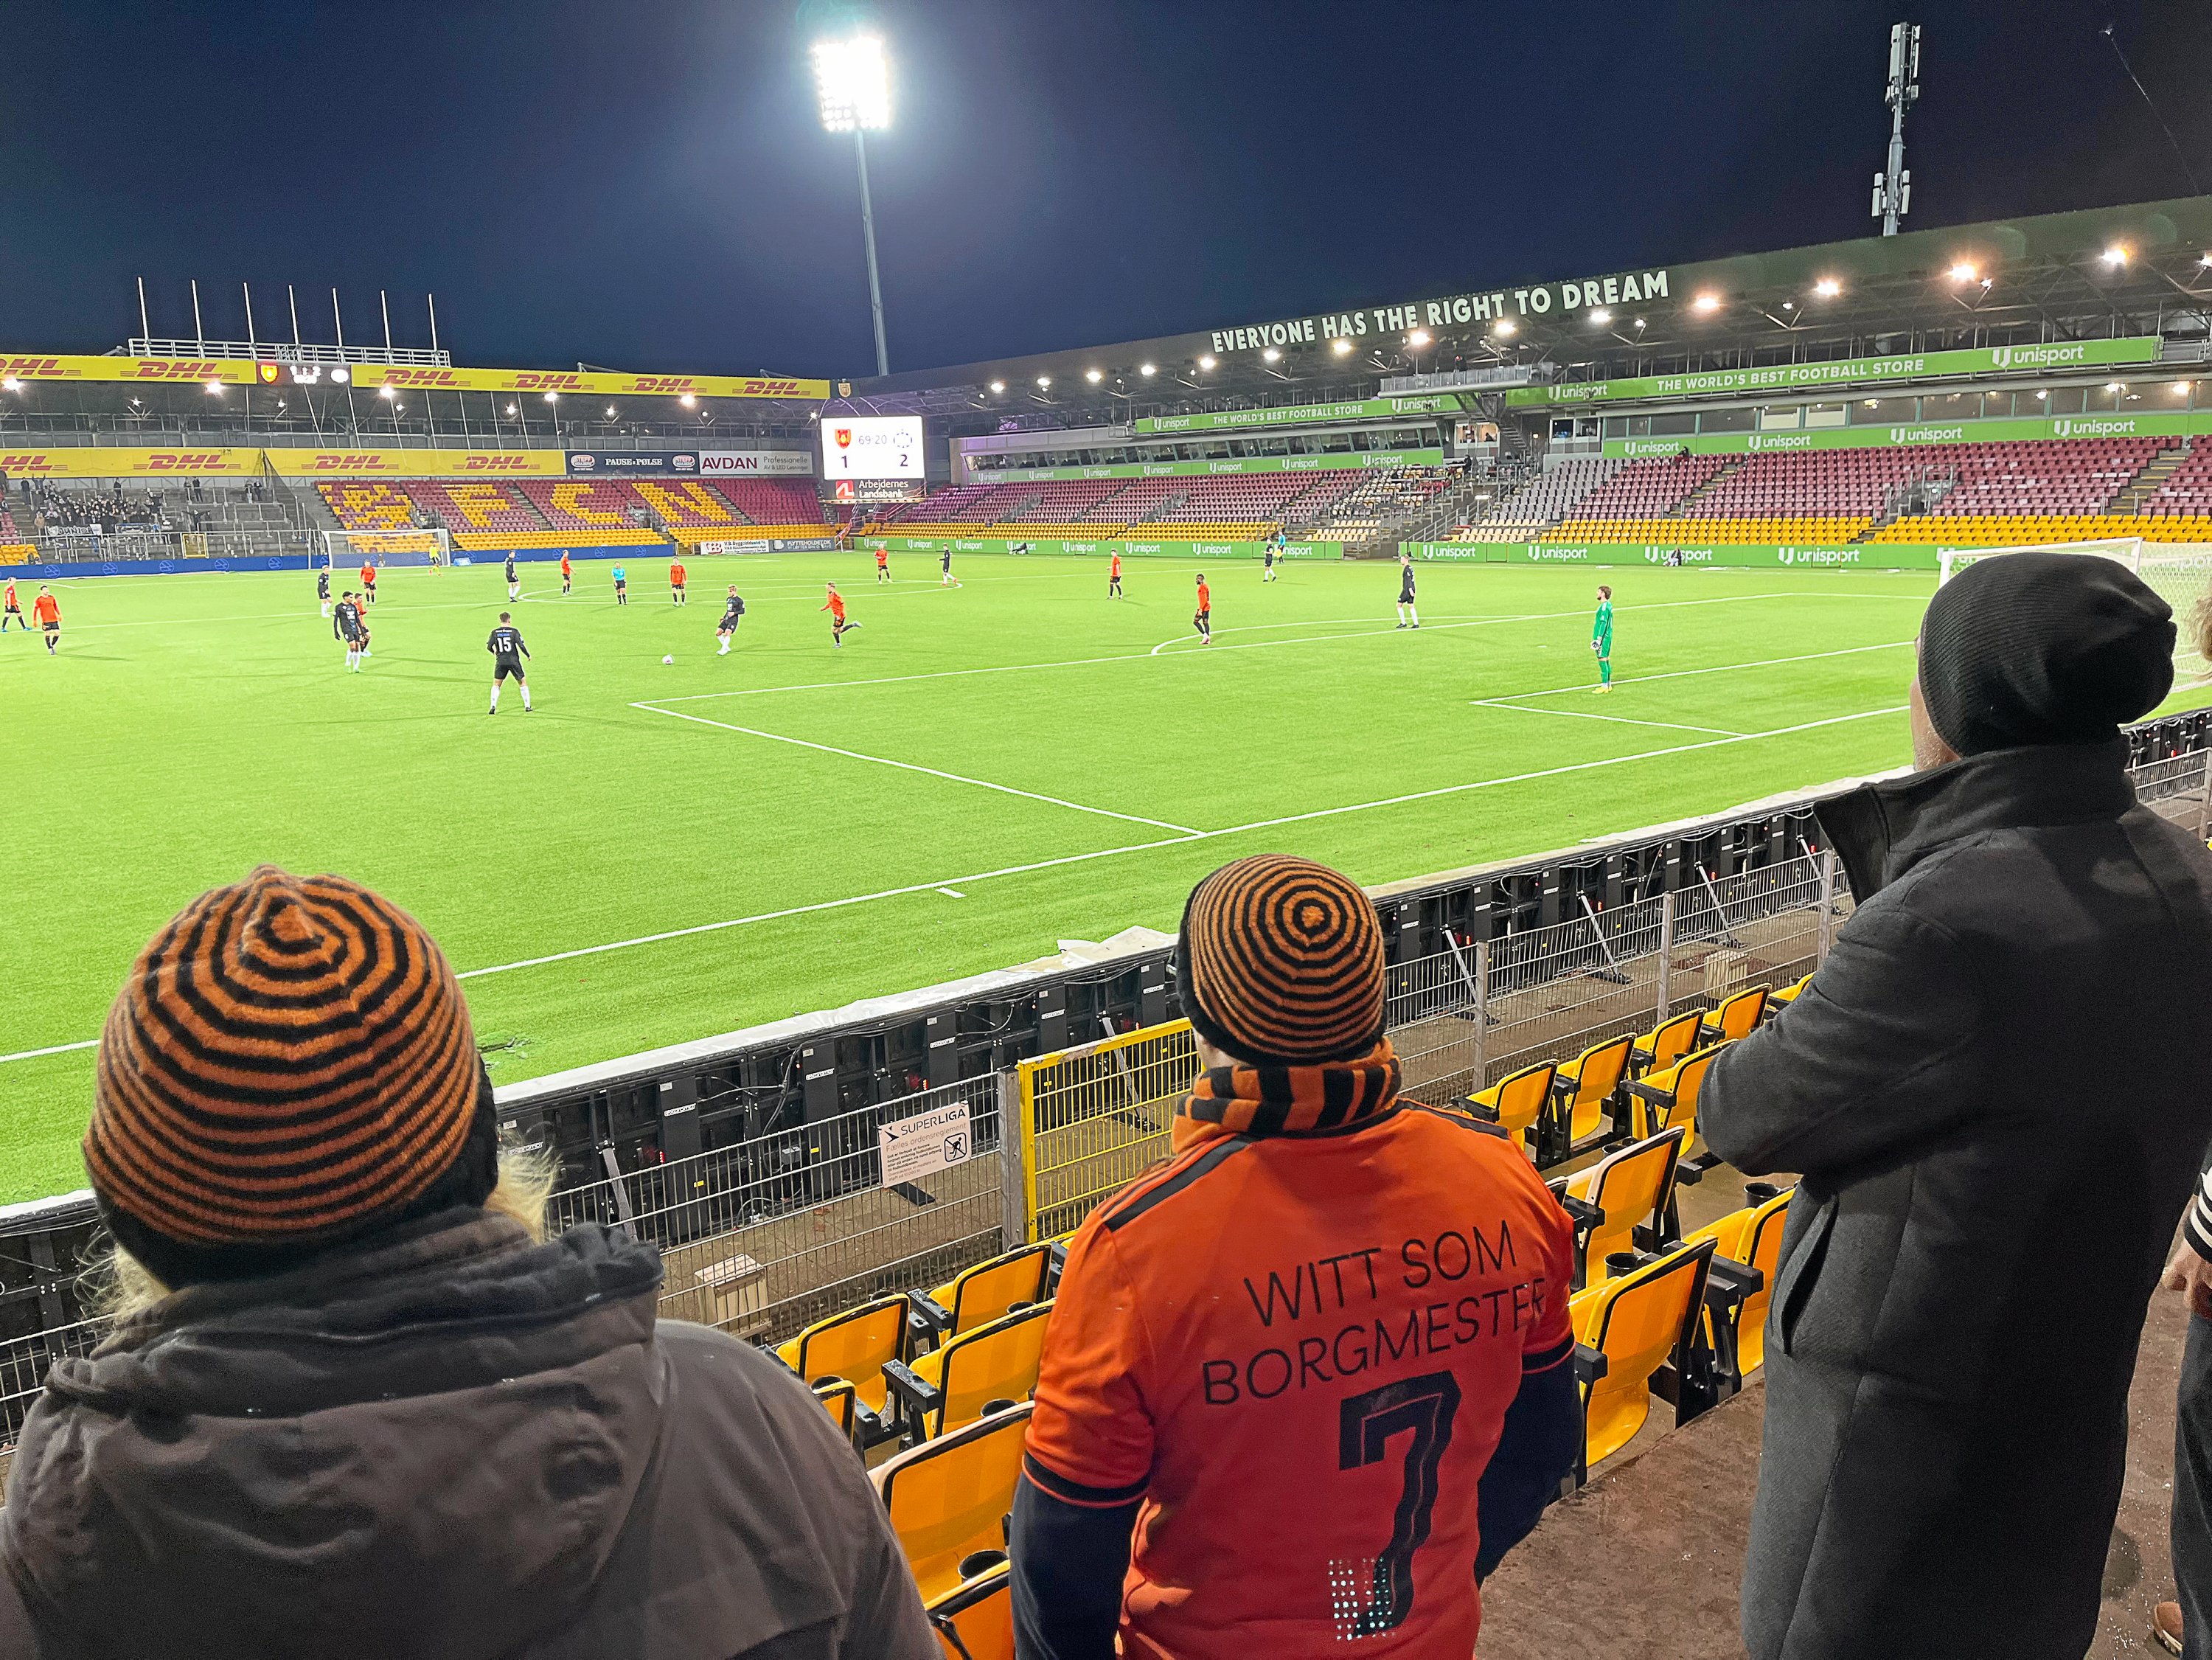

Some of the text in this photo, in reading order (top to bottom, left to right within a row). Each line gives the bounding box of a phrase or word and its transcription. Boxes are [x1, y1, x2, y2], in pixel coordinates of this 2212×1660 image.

[1211, 271, 1669, 353] EVERYONE HAS THE RIGHT TO DREAM
[2014, 345, 2084, 365] unisport
[137, 361, 221, 378] DHL
[1657, 359, 1924, 391] THE WORLD'S BEST FOOTBALL STORE
[383, 369, 459, 386] DHL
[515, 374, 582, 389] DHL
[635, 378, 696, 392] DHL
[743, 381, 801, 395] DHL
[1562, 384, 1607, 400] unisport
[1403, 397, 1441, 412] unisport
[1213, 405, 1363, 425] THE WORLD'S BEST FOOTBALL STORE
[1162, 418, 1189, 430] unisport
[2073, 420, 2135, 437] unisport
[858, 435, 887, 444] 69:20
[1907, 427, 1962, 442] unisport
[1638, 442, 1680, 455] unisport
[1762, 435, 1811, 450] unisport
[149, 454, 226, 470] DHL
[313, 455, 387, 470] DHL
[465, 456, 529, 470] DHL
[702, 457, 758, 469] AVDAN
[841, 455, 848, 468] 1
[900, 454, 908, 467] 2
[1217, 462, 1242, 473] unisport
[1290, 459, 1318, 470] unisport
[1034, 470, 1054, 479] unisport
[1090, 468, 1110, 477] unisport
[1150, 465, 1173, 475] unisport
[858, 480, 908, 490] Arbejdernes
[859, 489, 903, 499] Landsbank
[913, 540, 932, 549] unisport
[962, 541, 983, 551] unisport
[1071, 542, 1096, 554] unisport
[1138, 543, 1161, 555] unisport
[1202, 544, 1232, 556] unisport
[1283, 544, 1312, 558] nisport
[1435, 546, 1475, 560] unisport
[1542, 546, 1587, 562] unisport
[1660, 548, 1713, 563] unsport
[1797, 548, 1860, 566] unisport
[497, 637, 512, 652] 15
[901, 1108, 965, 1136] SUPERLIGA
[886, 1122, 966, 1152] Fælles ordensreglement
[1244, 1220, 1517, 1327] WITT SOM
[1338, 1369, 1461, 1639] 7
